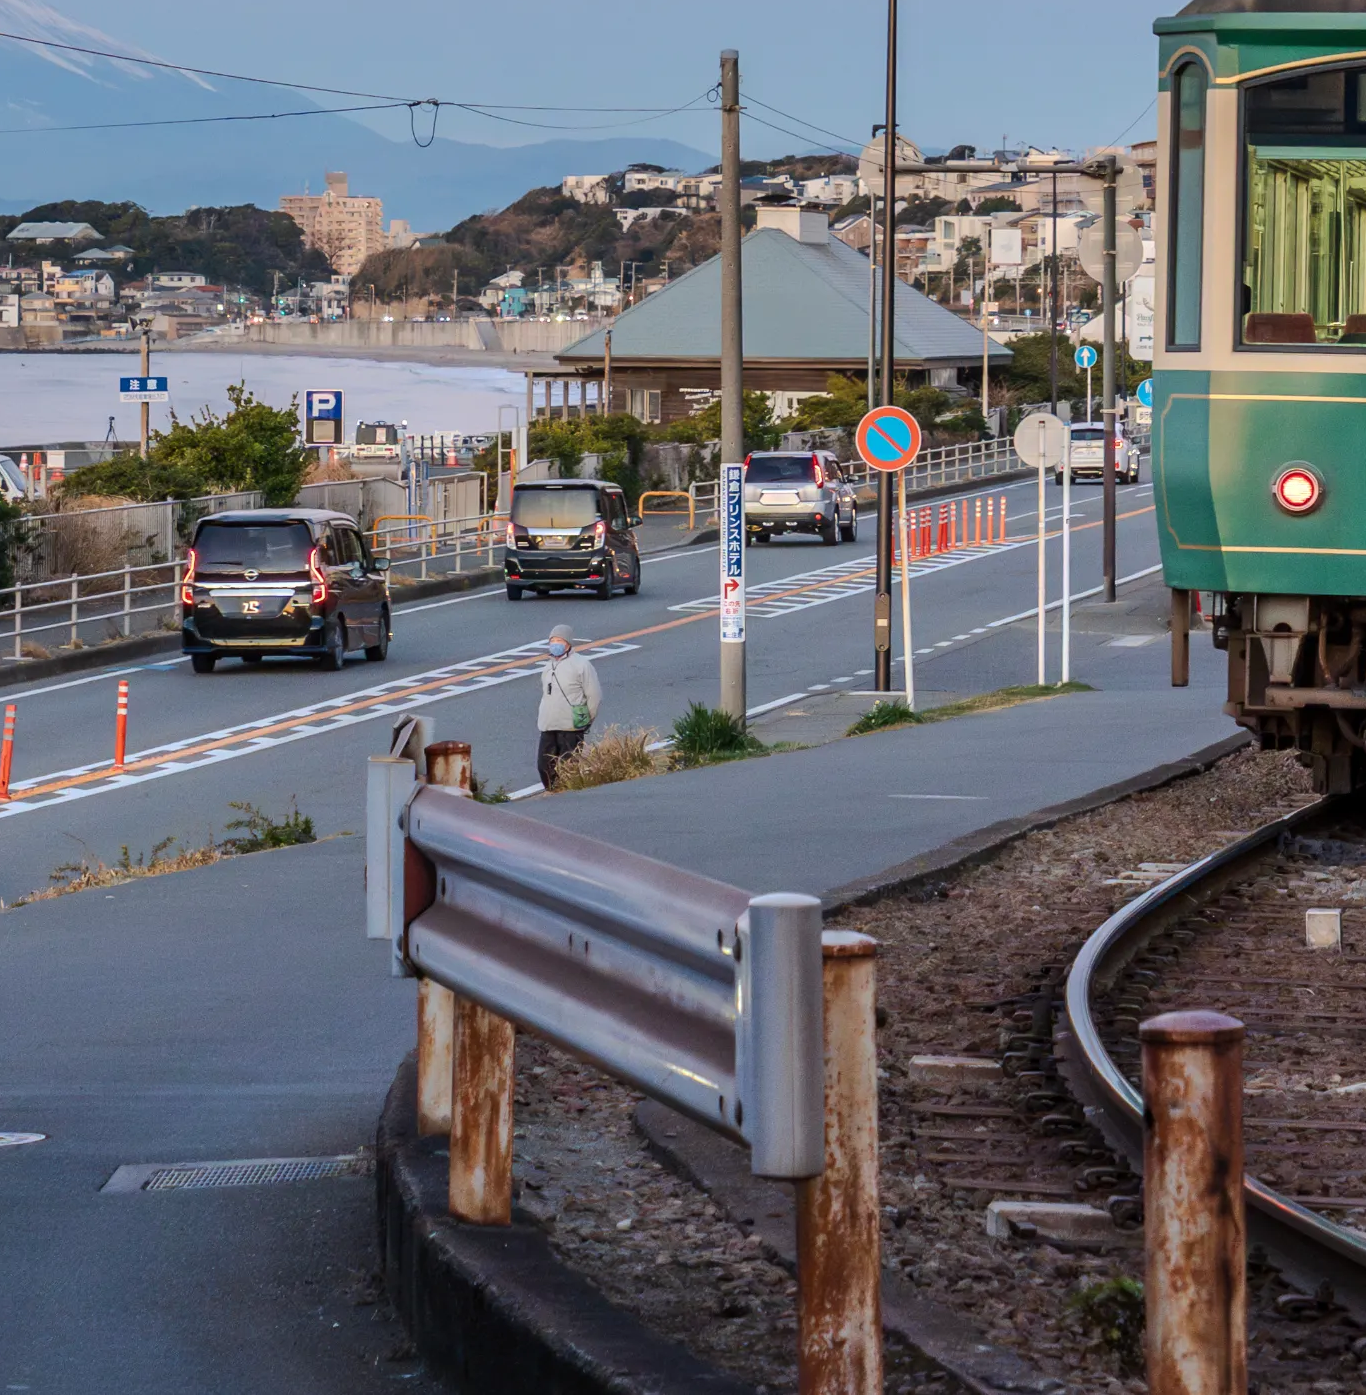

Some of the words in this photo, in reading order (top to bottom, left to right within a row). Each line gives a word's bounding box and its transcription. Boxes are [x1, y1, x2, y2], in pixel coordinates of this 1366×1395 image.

[312, 393, 336, 417] P
[728, 469, 741, 576] 鎌倉プリンスホテル
